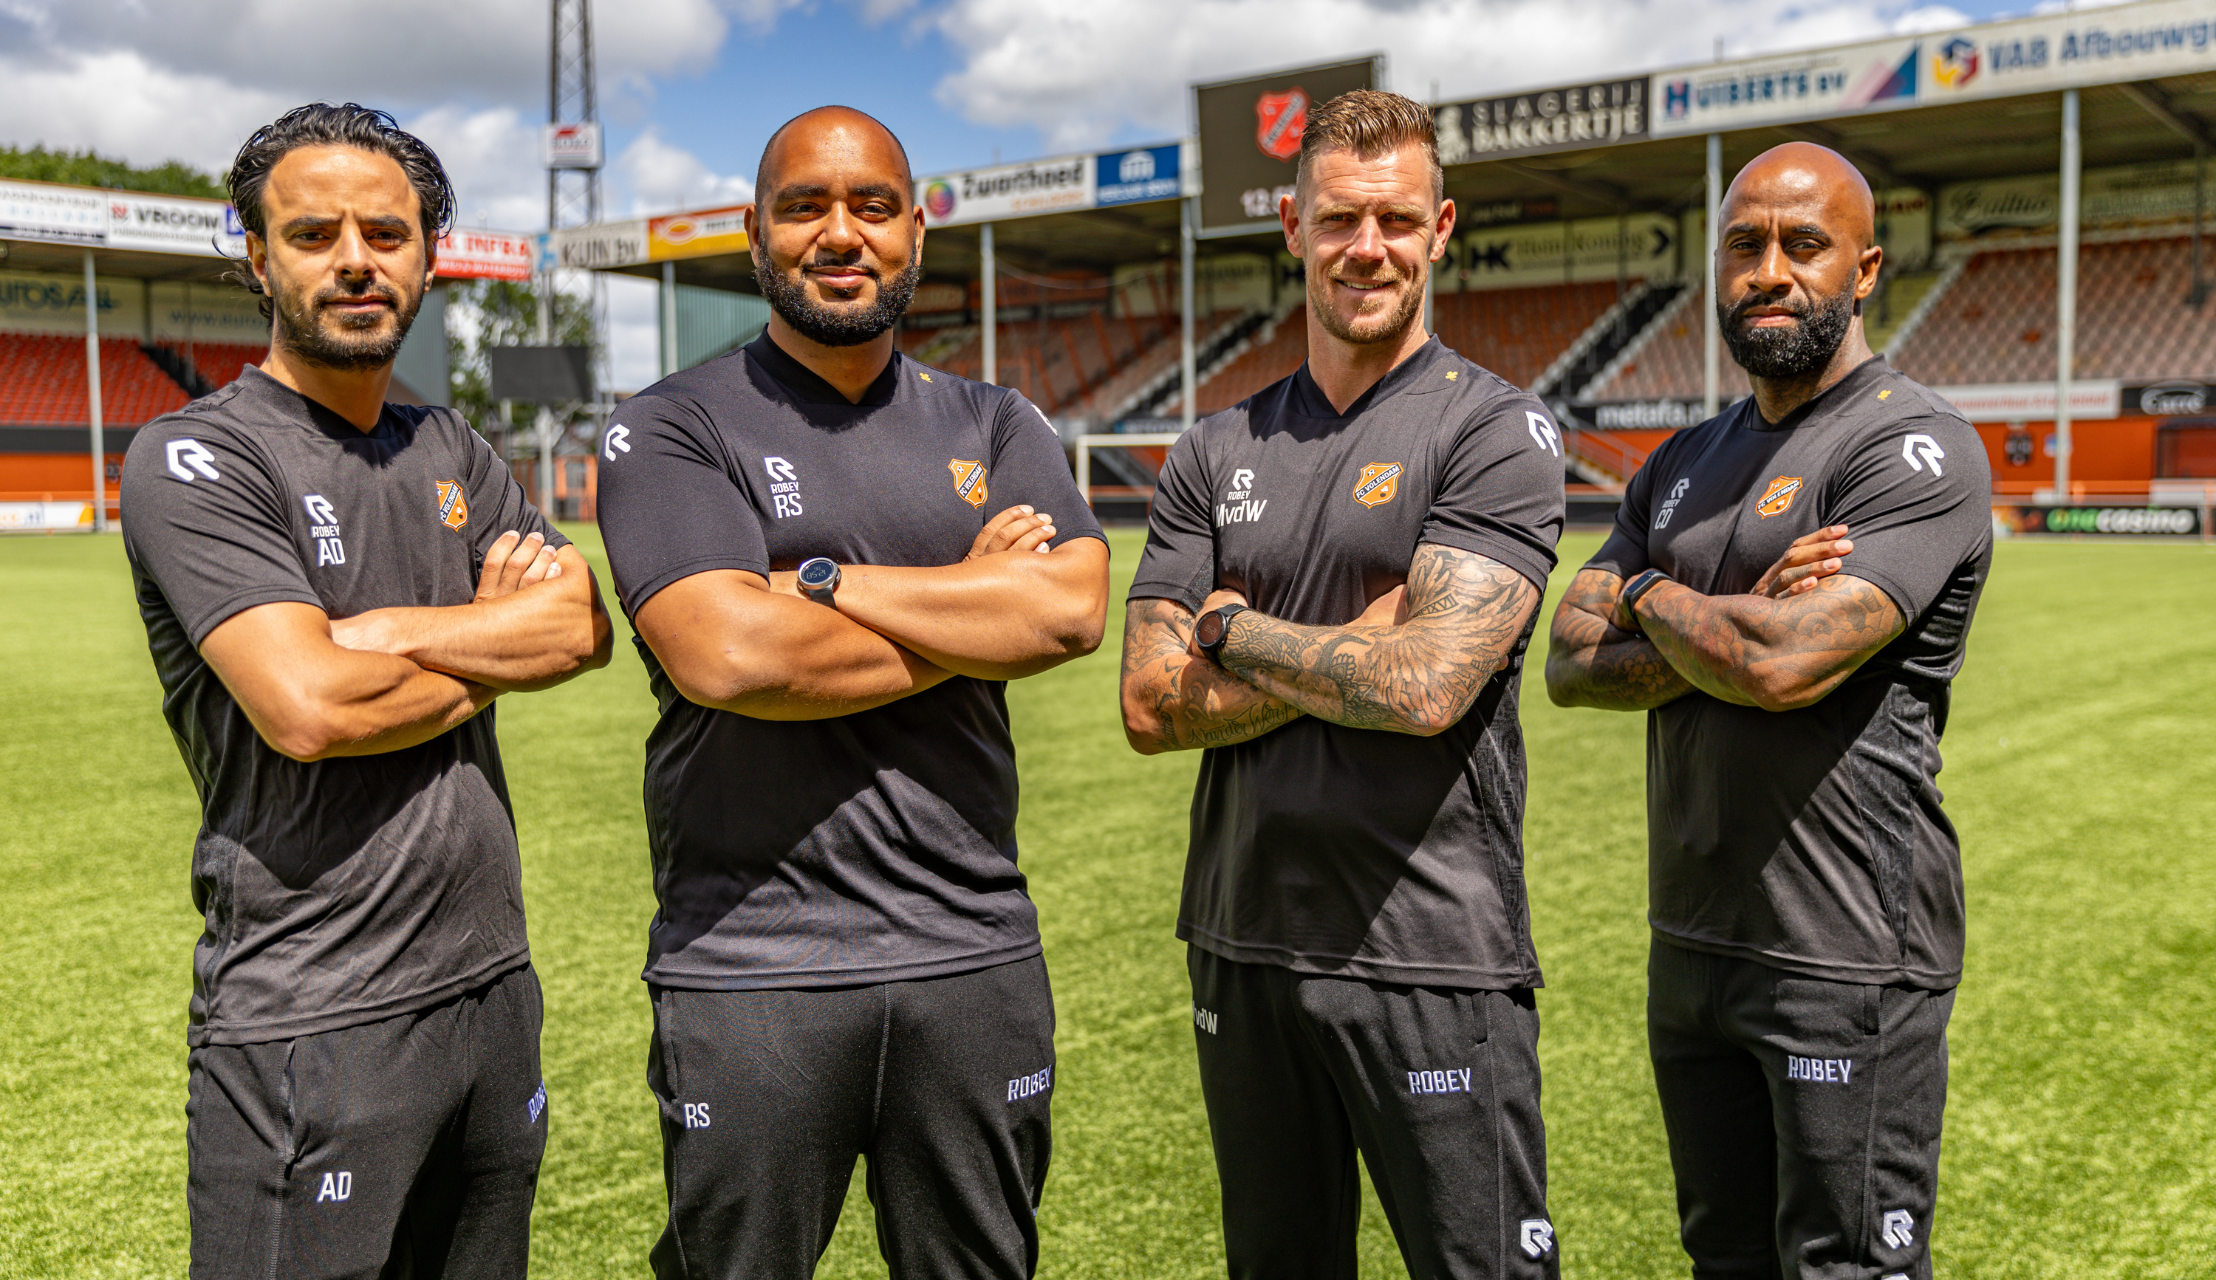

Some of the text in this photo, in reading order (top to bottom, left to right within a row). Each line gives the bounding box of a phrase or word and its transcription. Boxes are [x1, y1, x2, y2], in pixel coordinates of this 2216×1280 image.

[1988, 18, 2216, 75] VAB Afbouwg
[1472, 79, 1643, 127] SLAGERIJ
[1472, 104, 1644, 153] BAKKERTJE
[134, 205, 222, 231] VROOM
[1596, 399, 1705, 431] metafa.n
[771, 481, 799, 494] ROBEY
[1365, 465, 1400, 491] VOLENDAM
[774, 492, 803, 518] RS
[1227, 490, 1251, 501] ROBEY
[1215, 499, 1268, 528] MvdW
[1655, 508, 1674, 530] CD
[311, 525, 340, 538] ROBEY
[318, 538, 346, 567] AD
[1008, 1064, 1052, 1102] ROBEY
[1407, 1067, 1471, 1093] ROBEY
[1788, 1055, 1852, 1084] ROBEY
[684, 1102, 710, 1128] RS
[317, 1171, 352, 1203] AD
